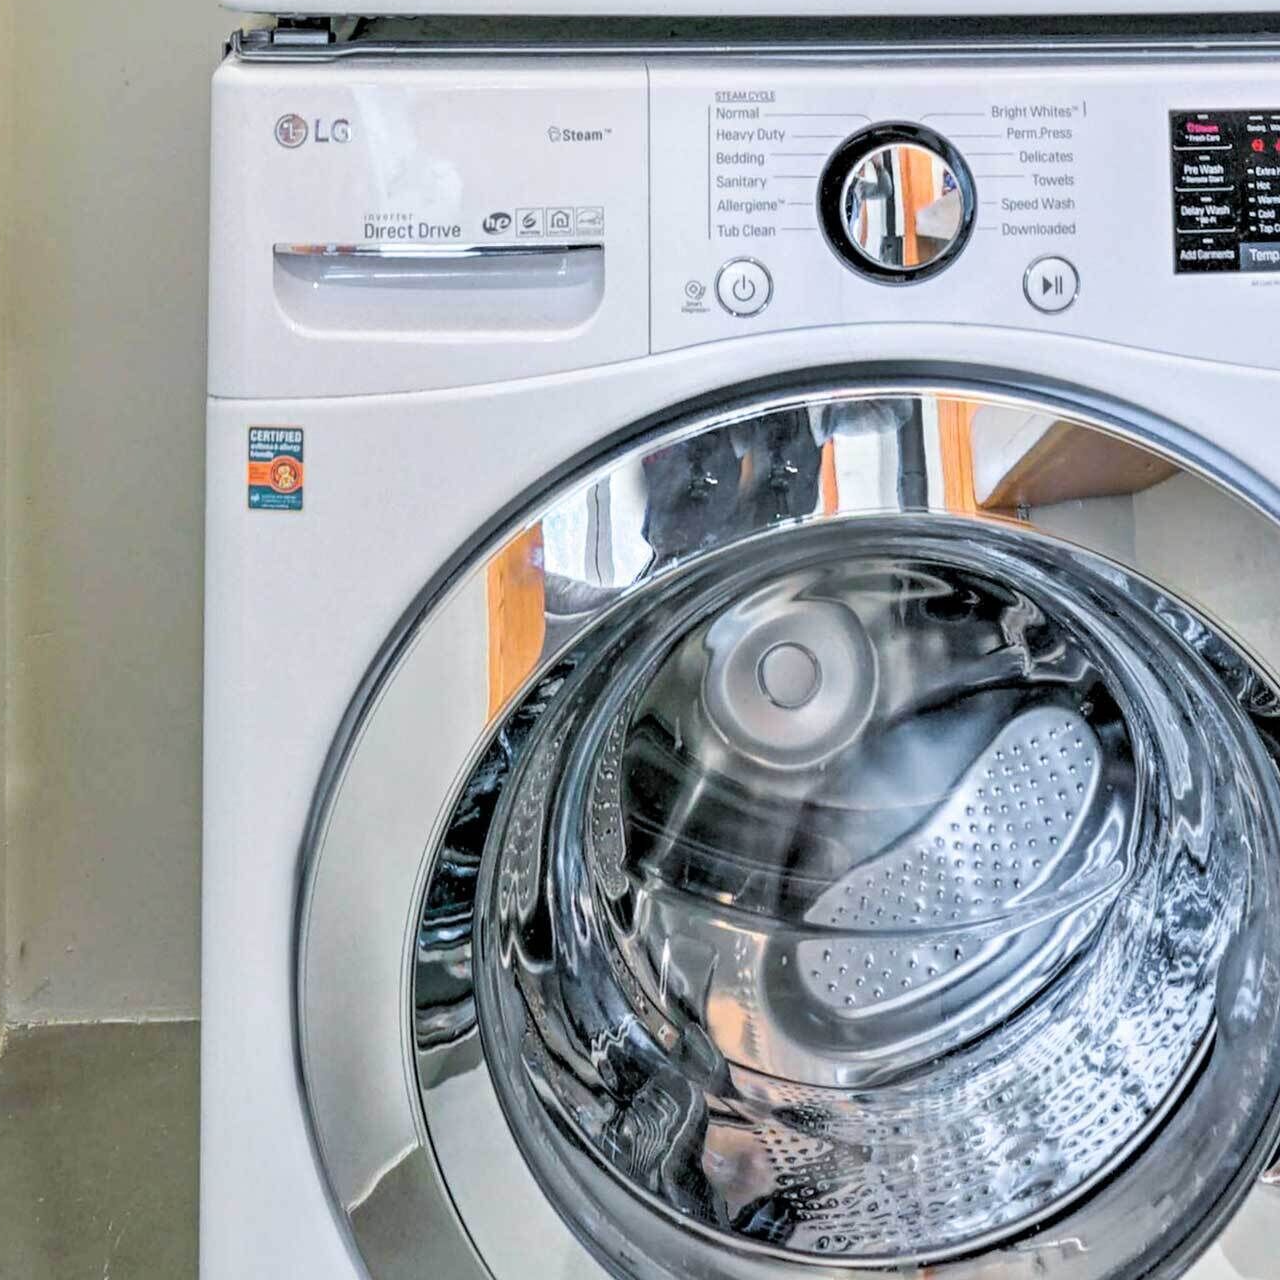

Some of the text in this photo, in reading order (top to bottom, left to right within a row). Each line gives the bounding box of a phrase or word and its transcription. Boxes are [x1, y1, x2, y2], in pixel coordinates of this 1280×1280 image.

[716, 106, 760, 119] Normal
[991, 105, 1027, 120] Bright
[314, 118, 353, 143] LG
[716, 127, 785, 142] Heavy Duty
[716, 151, 765, 166] Bedding
[1019, 150, 1074, 163] Delicates
[1199, 163, 1224, 175] Wash
[716, 175, 767, 189] Sanitary
[1032, 173, 1075, 186] Towels
[1256, 181, 1271, 191] Hot
[1001, 197, 1076, 212] Speed Wash
[1257, 195, 1280, 204] Warm
[1181, 205, 1230, 216] Delay Wash
[1257, 209, 1276, 219] Cold
[363, 222, 461, 239] Direct Drive
[716, 223, 777, 238] Tub Clean
[1001, 221, 1077, 236] Downloaded
[1259, 223, 1274, 234] Tap
[1180, 249, 1235, 260] Add Garments
[250, 429, 302, 443] CERTIFIED
